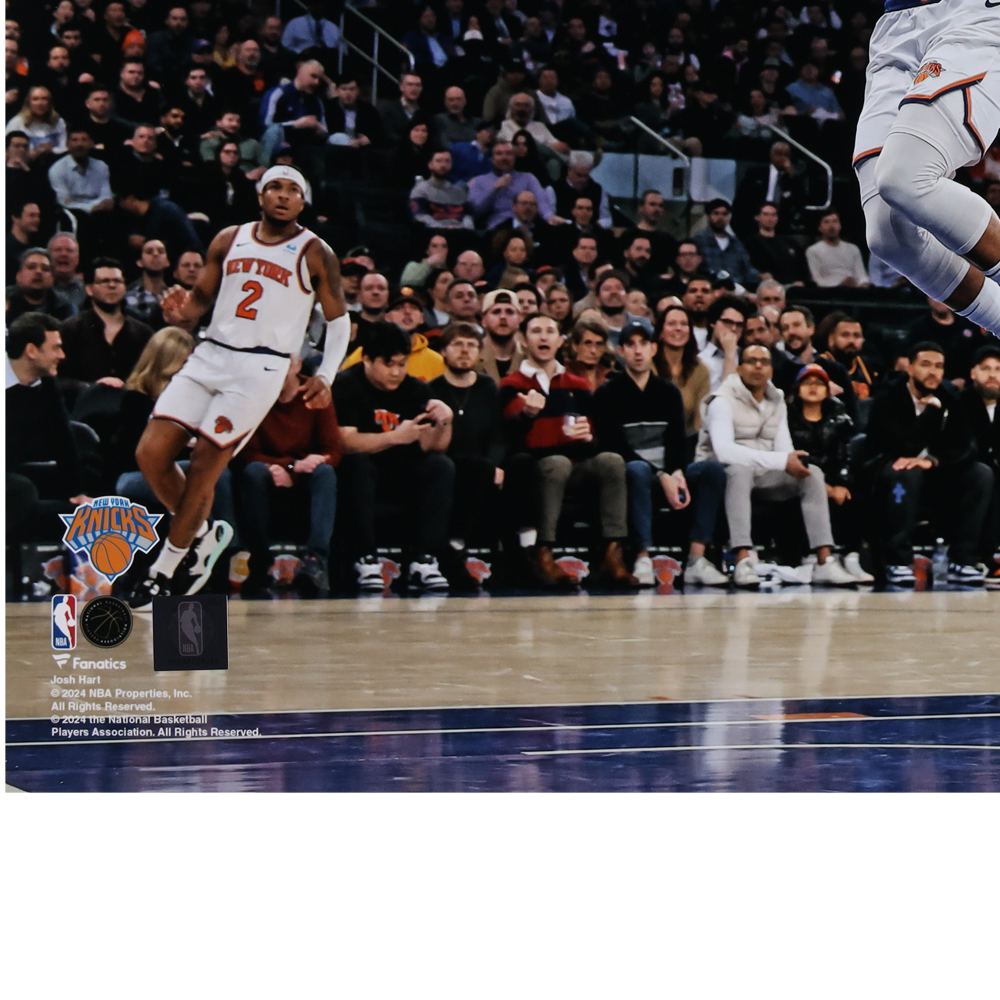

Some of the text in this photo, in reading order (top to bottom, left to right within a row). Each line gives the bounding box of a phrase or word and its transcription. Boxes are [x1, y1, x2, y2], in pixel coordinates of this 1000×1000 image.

[226, 257, 293, 288] NEW YORK
[235, 280, 263, 321] 2
[182, 643, 194, 653] NBA
